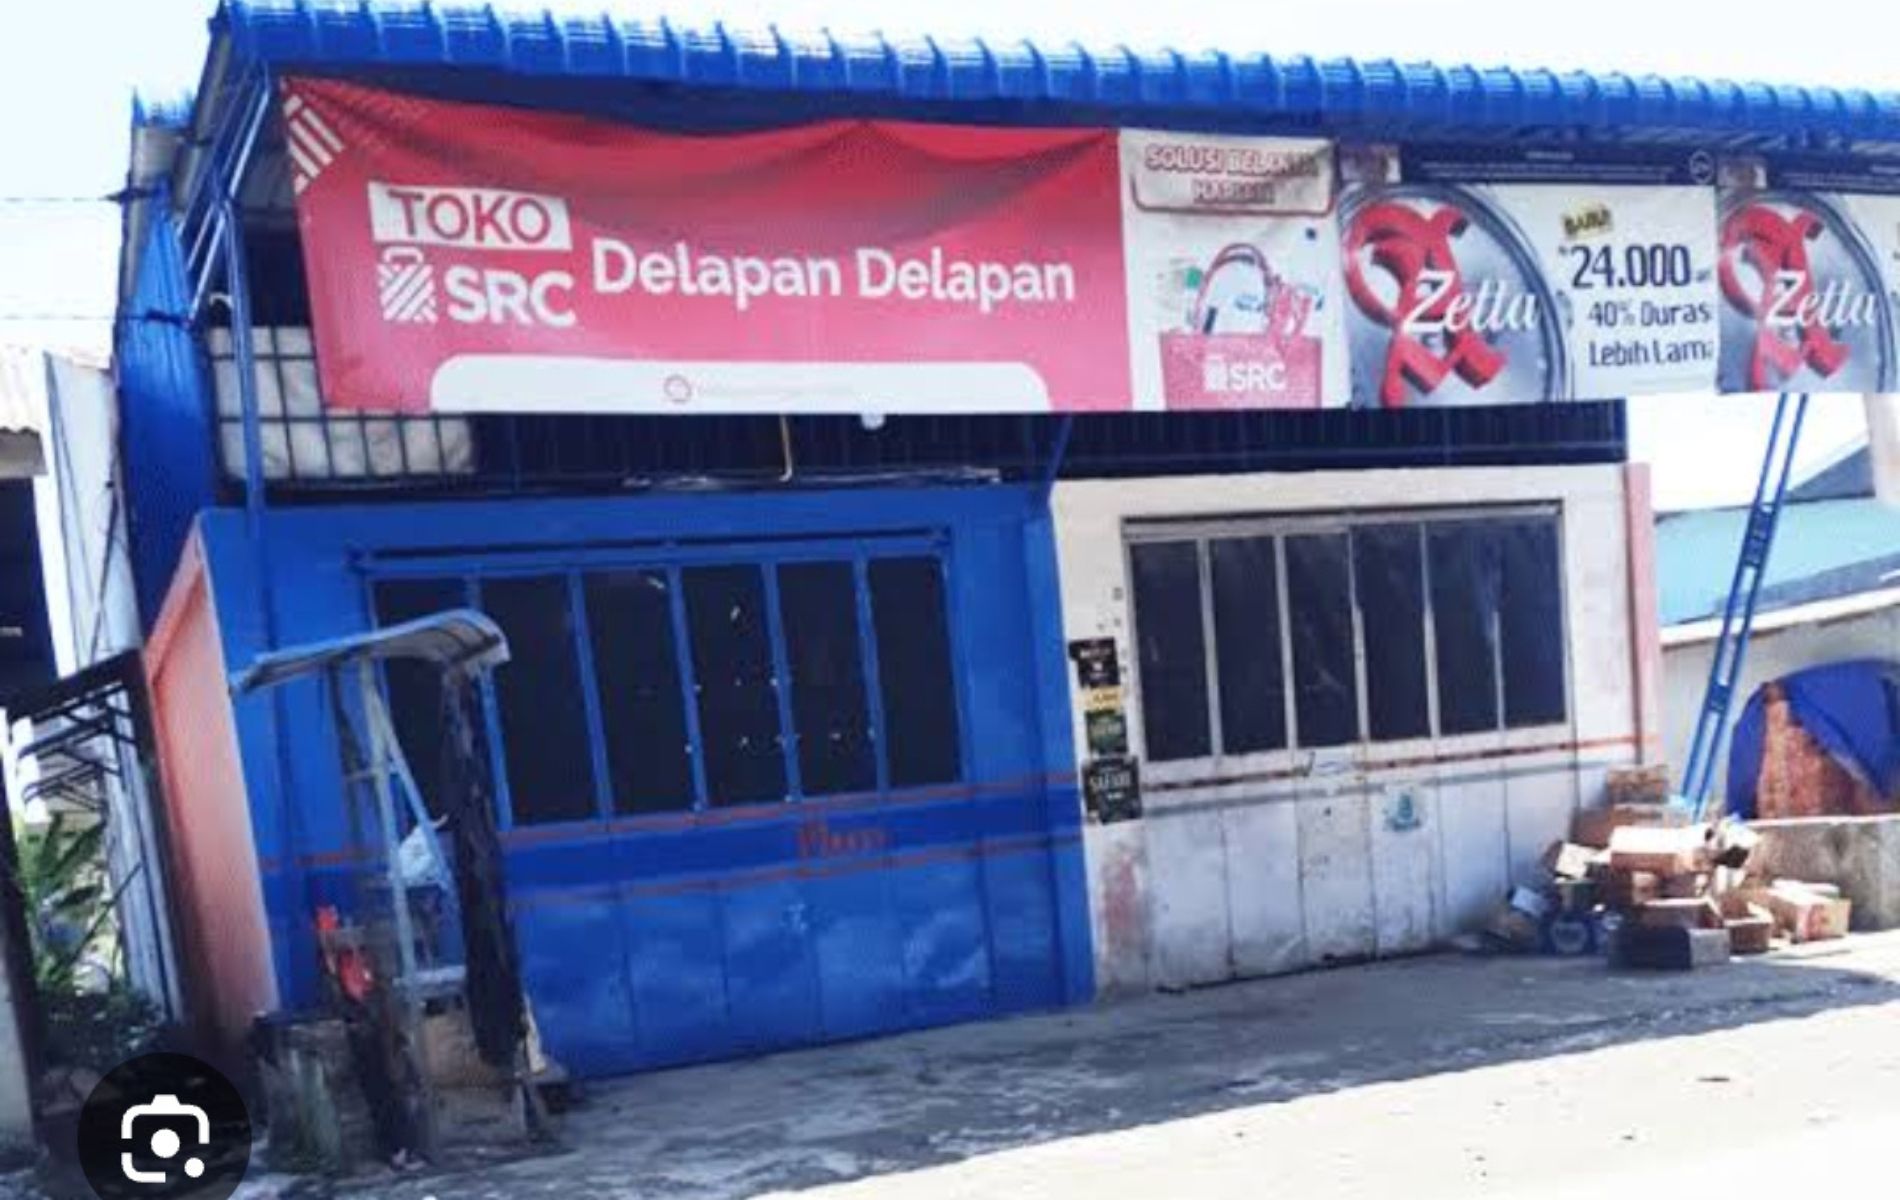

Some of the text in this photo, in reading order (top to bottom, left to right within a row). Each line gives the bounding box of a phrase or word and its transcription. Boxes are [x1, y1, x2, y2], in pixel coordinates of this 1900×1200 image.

[387, 189, 551, 244] TOKO
[592, 237, 1075, 314] Delapan Delapan
[1571, 243, 1691, 289] 24.000
[444, 265, 577, 327] SRC
[1227, 361, 1288, 390] SRC
[1589, 339, 1650, 367] Lebih
